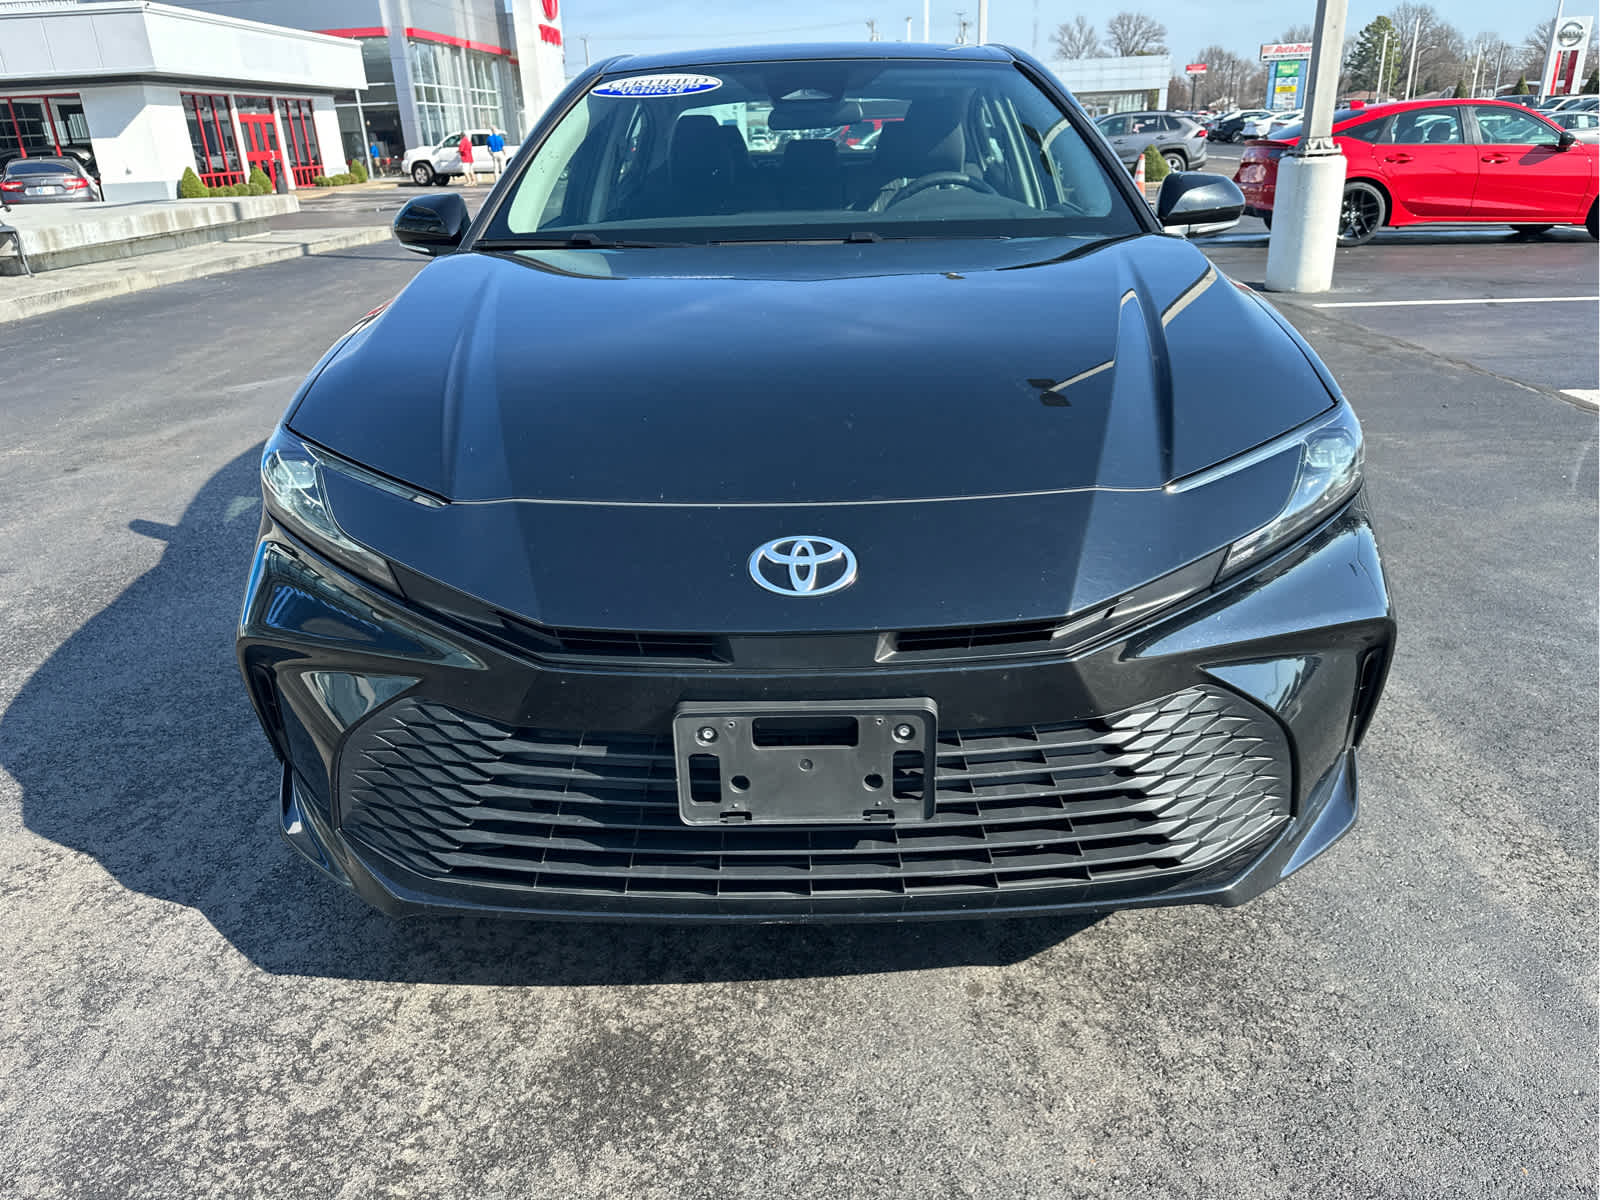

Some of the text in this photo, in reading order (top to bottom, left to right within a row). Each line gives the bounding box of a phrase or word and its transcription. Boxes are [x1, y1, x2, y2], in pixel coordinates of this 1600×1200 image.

[1274, 44, 1312, 54] AutoZon
[608, 78, 708, 89] CERTIFIED
[621, 87, 685, 95] VEHICLE
